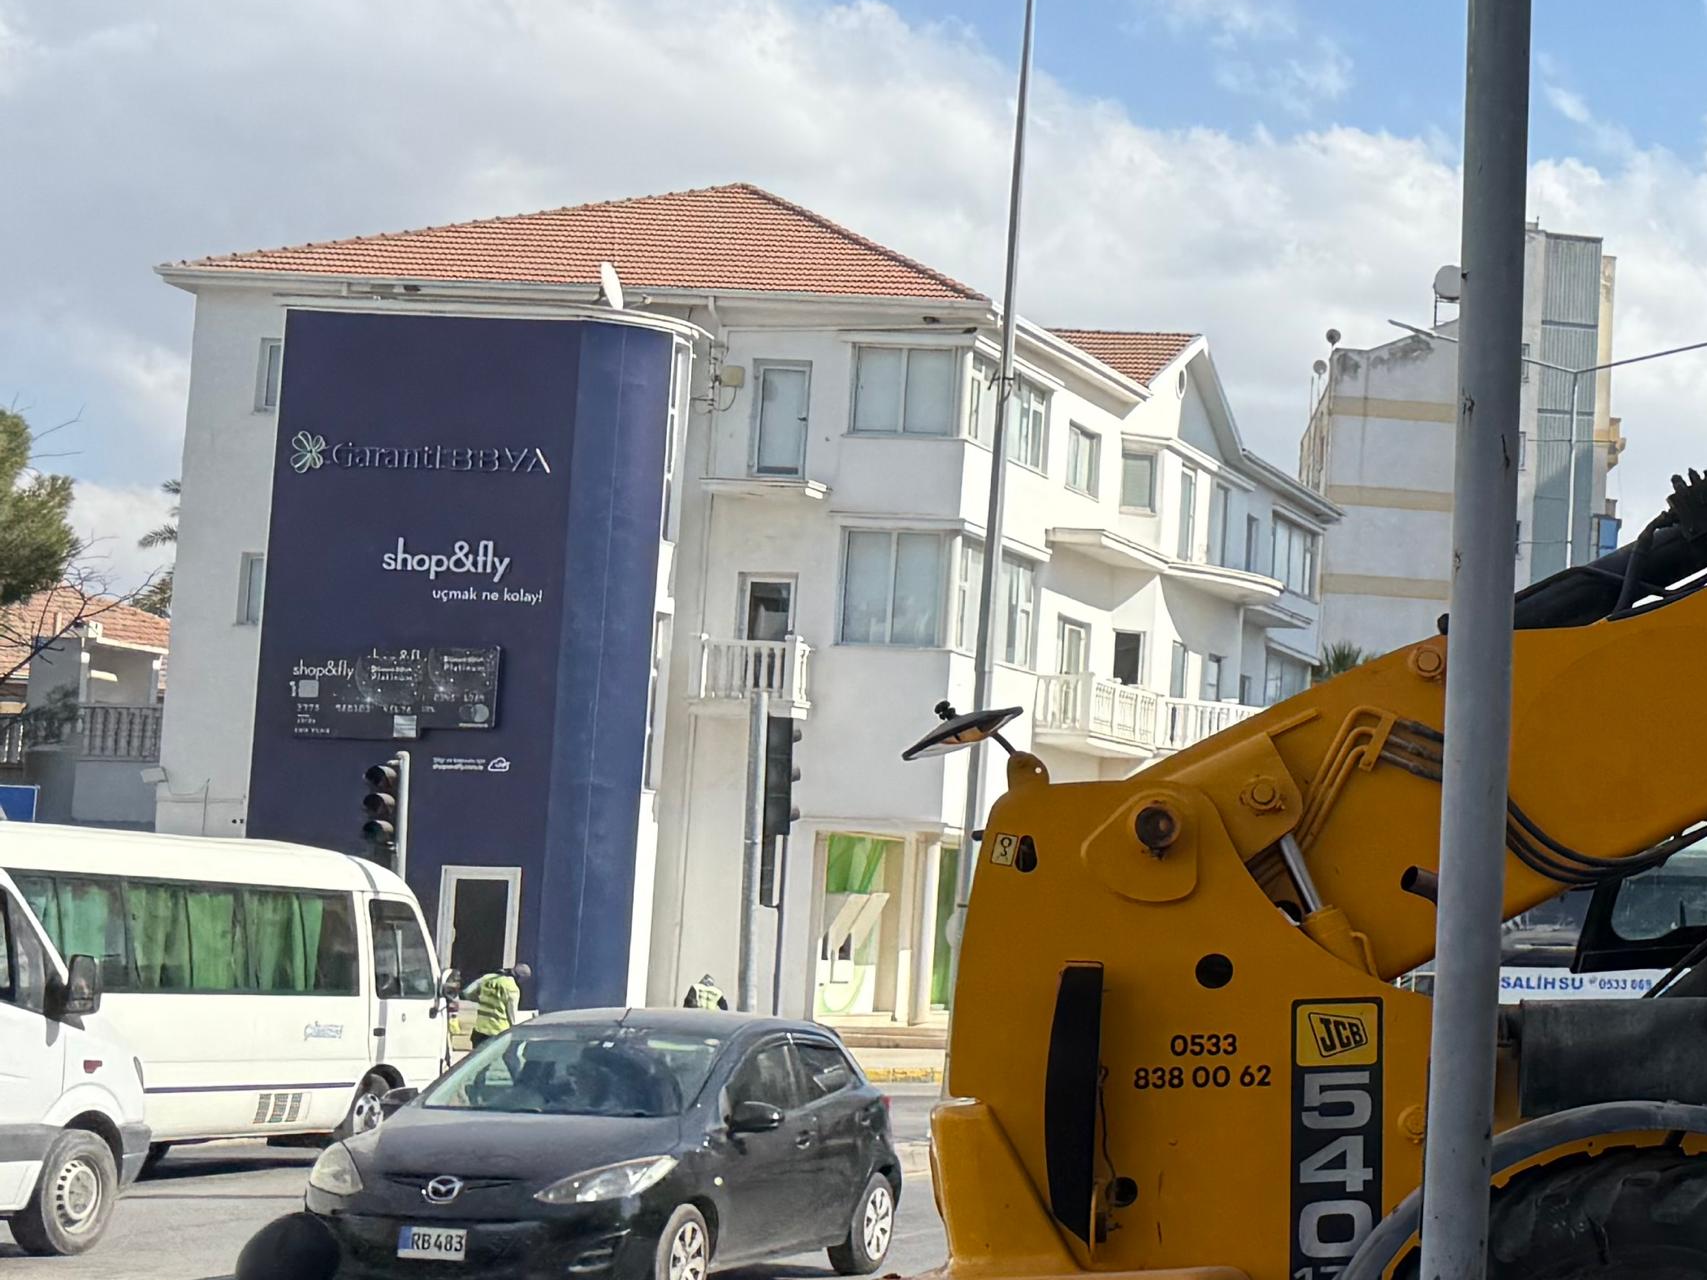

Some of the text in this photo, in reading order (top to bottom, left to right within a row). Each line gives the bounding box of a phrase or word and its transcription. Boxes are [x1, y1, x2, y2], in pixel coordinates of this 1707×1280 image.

[382, 537, 510, 583] shop&fly
[432, 587, 543, 606] uçmak ne kolay!
[292, 659, 354, 680] shop&fly
[1170, 1033, 1238, 1057] 0533
[1318, 1016, 1365, 1053] JCB
[1133, 1064, 1272, 1090] 838 00 62
[1298, 1071, 1373, 1258] 540
[411, 1232, 465, 1252] RB 483
